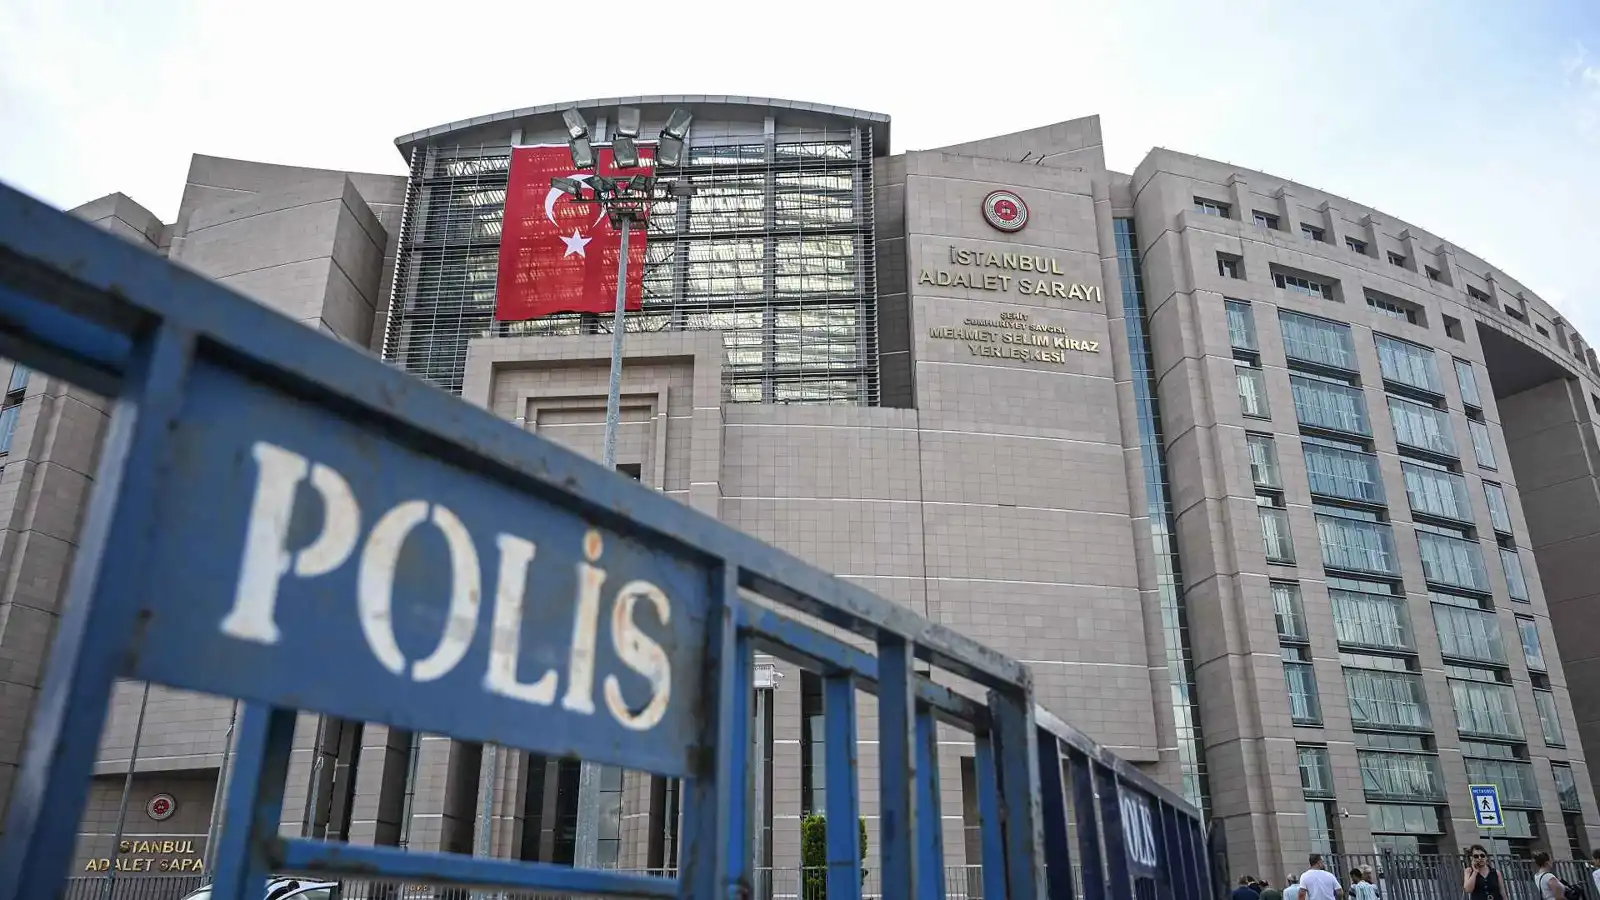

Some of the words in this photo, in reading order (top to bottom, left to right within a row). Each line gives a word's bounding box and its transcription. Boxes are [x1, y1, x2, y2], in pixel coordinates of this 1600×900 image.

[950, 245, 1064, 275] İSTANBUL
[918, 269, 1011, 291] ADALET
[1018, 278, 1101, 302] SARAYI
[929, 327, 999, 342] MEHMET
[1002, 332, 1049, 347] SELİM
[1053, 335, 1100, 353] KİRAZ
[968, 344, 1066, 364] YERLEŞKESİ
[221, 441, 671, 731] POLİS
[119, 840, 195, 853] STANBUL
